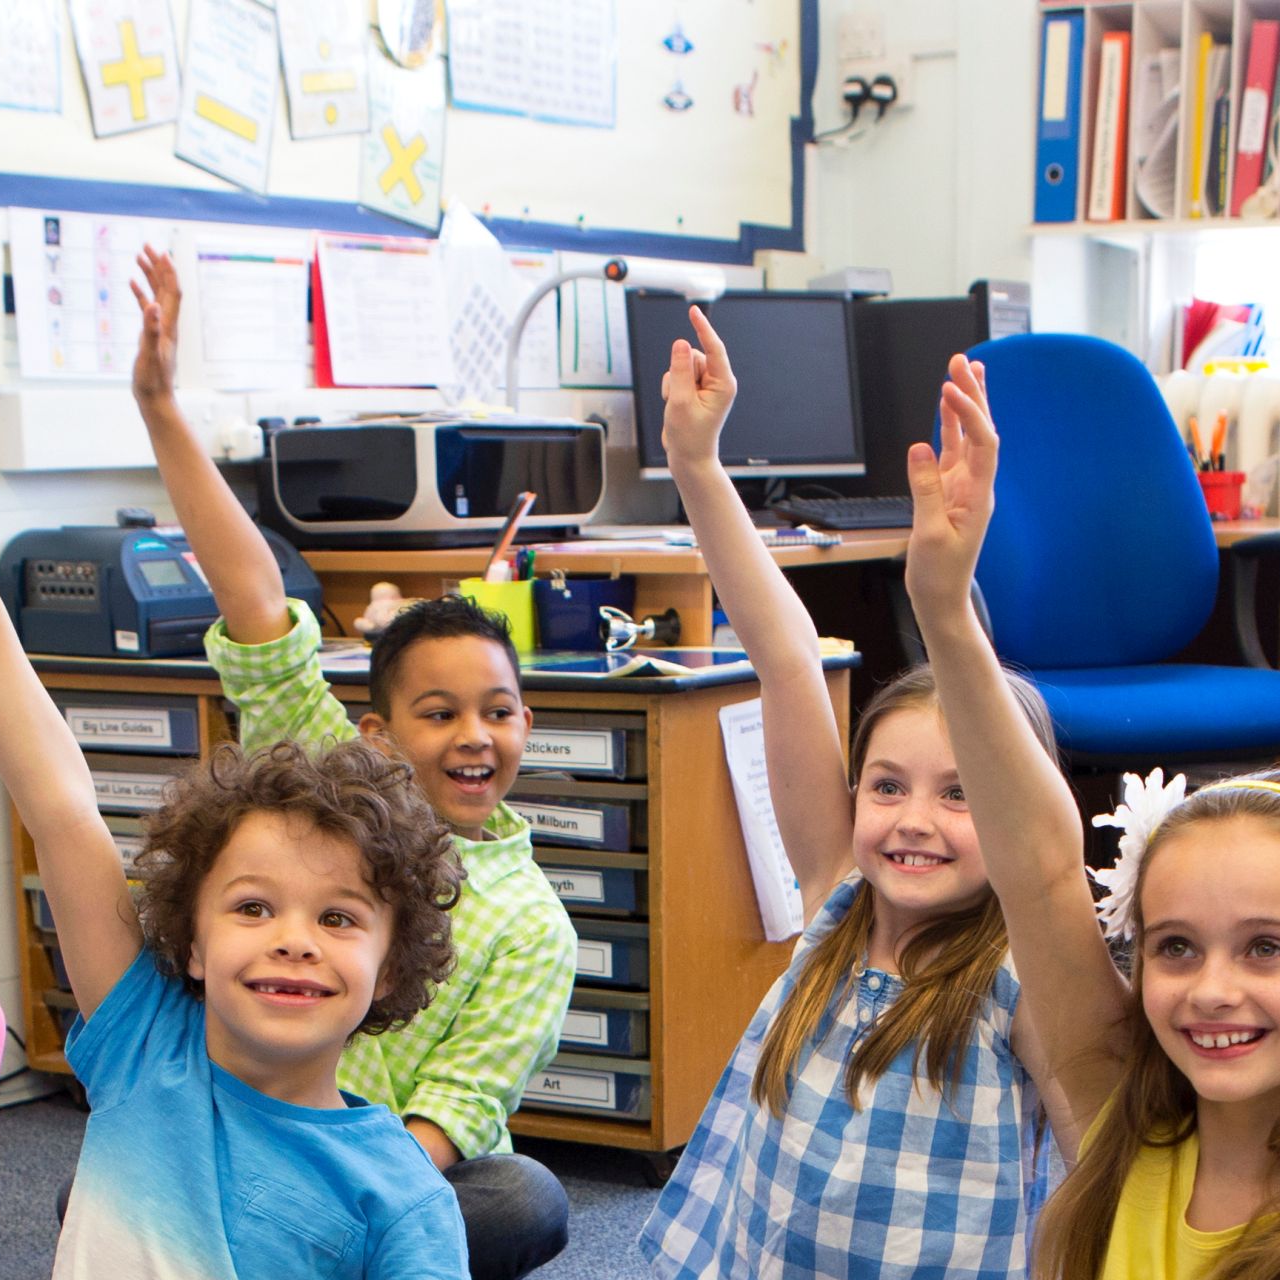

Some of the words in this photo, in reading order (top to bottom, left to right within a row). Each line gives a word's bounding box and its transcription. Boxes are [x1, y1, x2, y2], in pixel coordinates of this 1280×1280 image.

[82, 720, 98, 735] Big
[99, 721, 120, 733] Line
[121, 722, 154, 734] Guides
[524, 741, 571, 755] Stickers
[112, 784, 132, 796] Line
[134, 785, 162, 797] Guide
[536, 813, 579, 831] Milburn
[542, 1077, 561, 1091] Art
